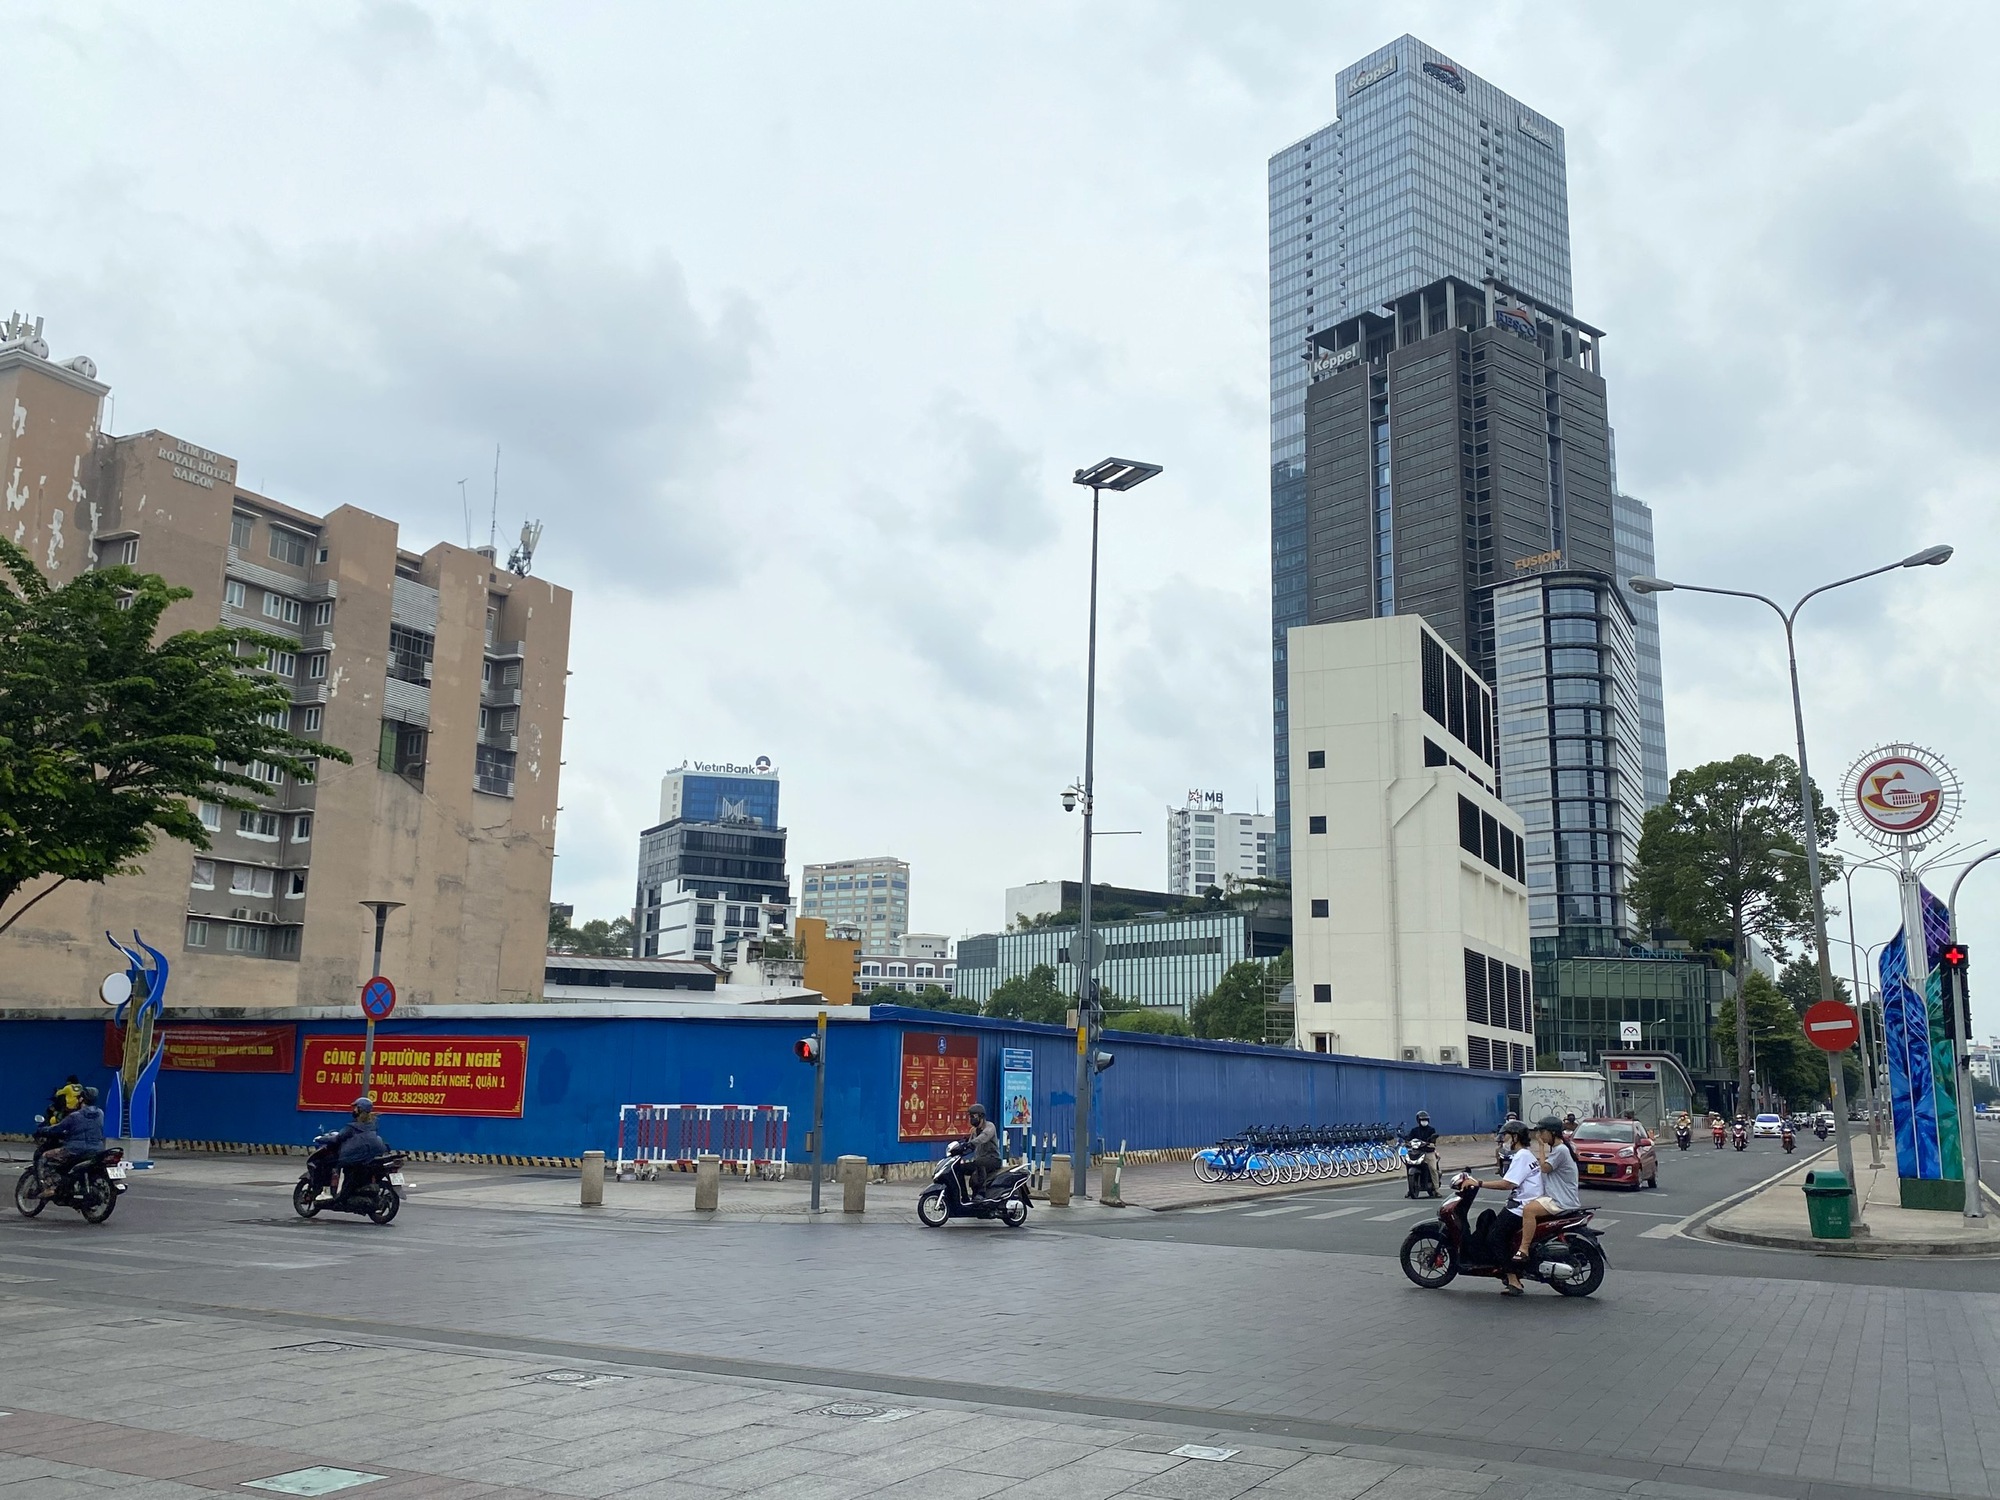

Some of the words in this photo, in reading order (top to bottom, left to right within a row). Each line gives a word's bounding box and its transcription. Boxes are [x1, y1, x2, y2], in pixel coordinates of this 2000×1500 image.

[1348, 58, 1394, 92] Keppel
[1520, 117, 1552, 146] Keppel
[1313, 344, 1356, 373] Keppel
[177, 440, 199, 457] KIM
[158, 447, 195, 468] ROYAL
[198, 461, 232, 483] HOTEL
[173, 467, 214, 489] SAIGON
[1514, 549, 1562, 571] FUSION
[694, 761, 755, 774] VietinBank
[1205, 792, 1223, 802] MB
[323, 1047, 356, 1065] CÔNG
[379, 1047, 431, 1066] PHƯỜNG
[434, 1046, 462, 1067] BẾN
[465, 1048, 502, 1068] NGHÉ
[330, 1072, 340, 1084] 74
[354, 1070, 375, 1085] TÙG
[375, 1070, 396, 1087] MẬU,
[397, 1070, 429, 1086] PHƯỜNG
[430, 1070, 448, 1087] BẾN
[449, 1072, 474, 1089] NGHÉ,
[475, 1072, 499, 1089] QUẬN
[500, 1075, 506, 1088] 1
[381, 1091, 446, 1105] 028.38298927
